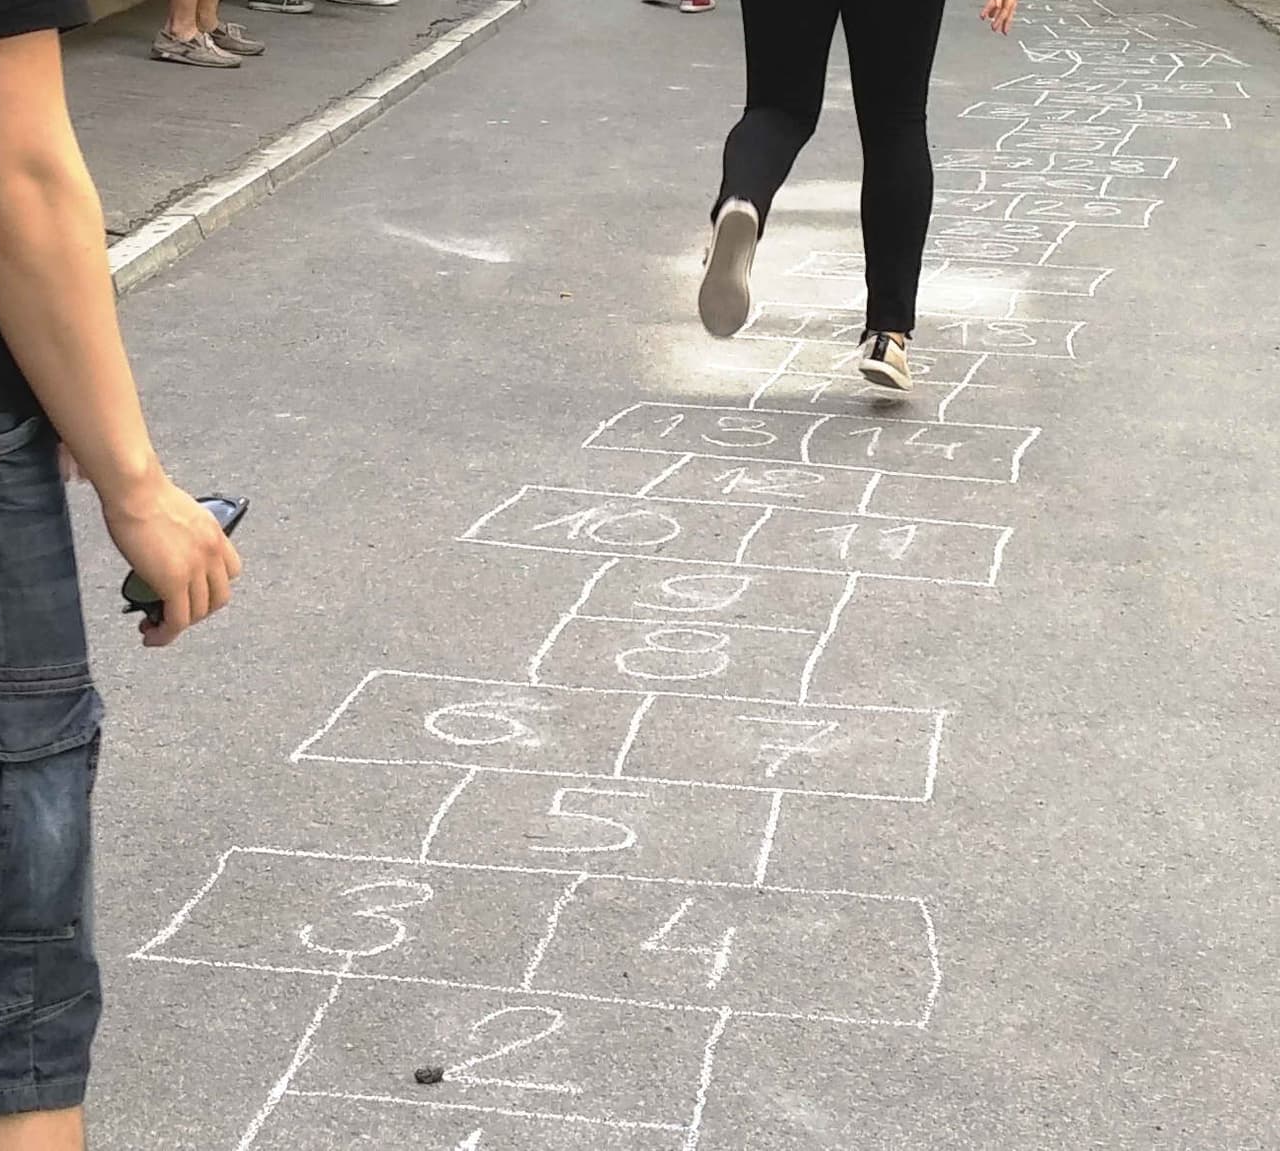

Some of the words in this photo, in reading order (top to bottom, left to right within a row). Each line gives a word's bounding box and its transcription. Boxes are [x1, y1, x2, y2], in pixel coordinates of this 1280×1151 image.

[1061, 158, 1146, 174] 28
[1025, 199, 1123, 217] 25
[652, 413, 780, 448] 13
[847, 426, 967, 461] 14
[712, 466, 826, 499] 12
[532, 502, 684, 548] 10
[632, 573, 754, 613] 9
[615, 628, 731, 681] 8
[423, 701, 548, 747] 6
[735, 714, 840, 779] 7
[527, 786, 650, 853] 5
[298, 879, 434, 957] 3
[639, 895, 735, 991] 4
[442, 1005, 584, 1095] 2
